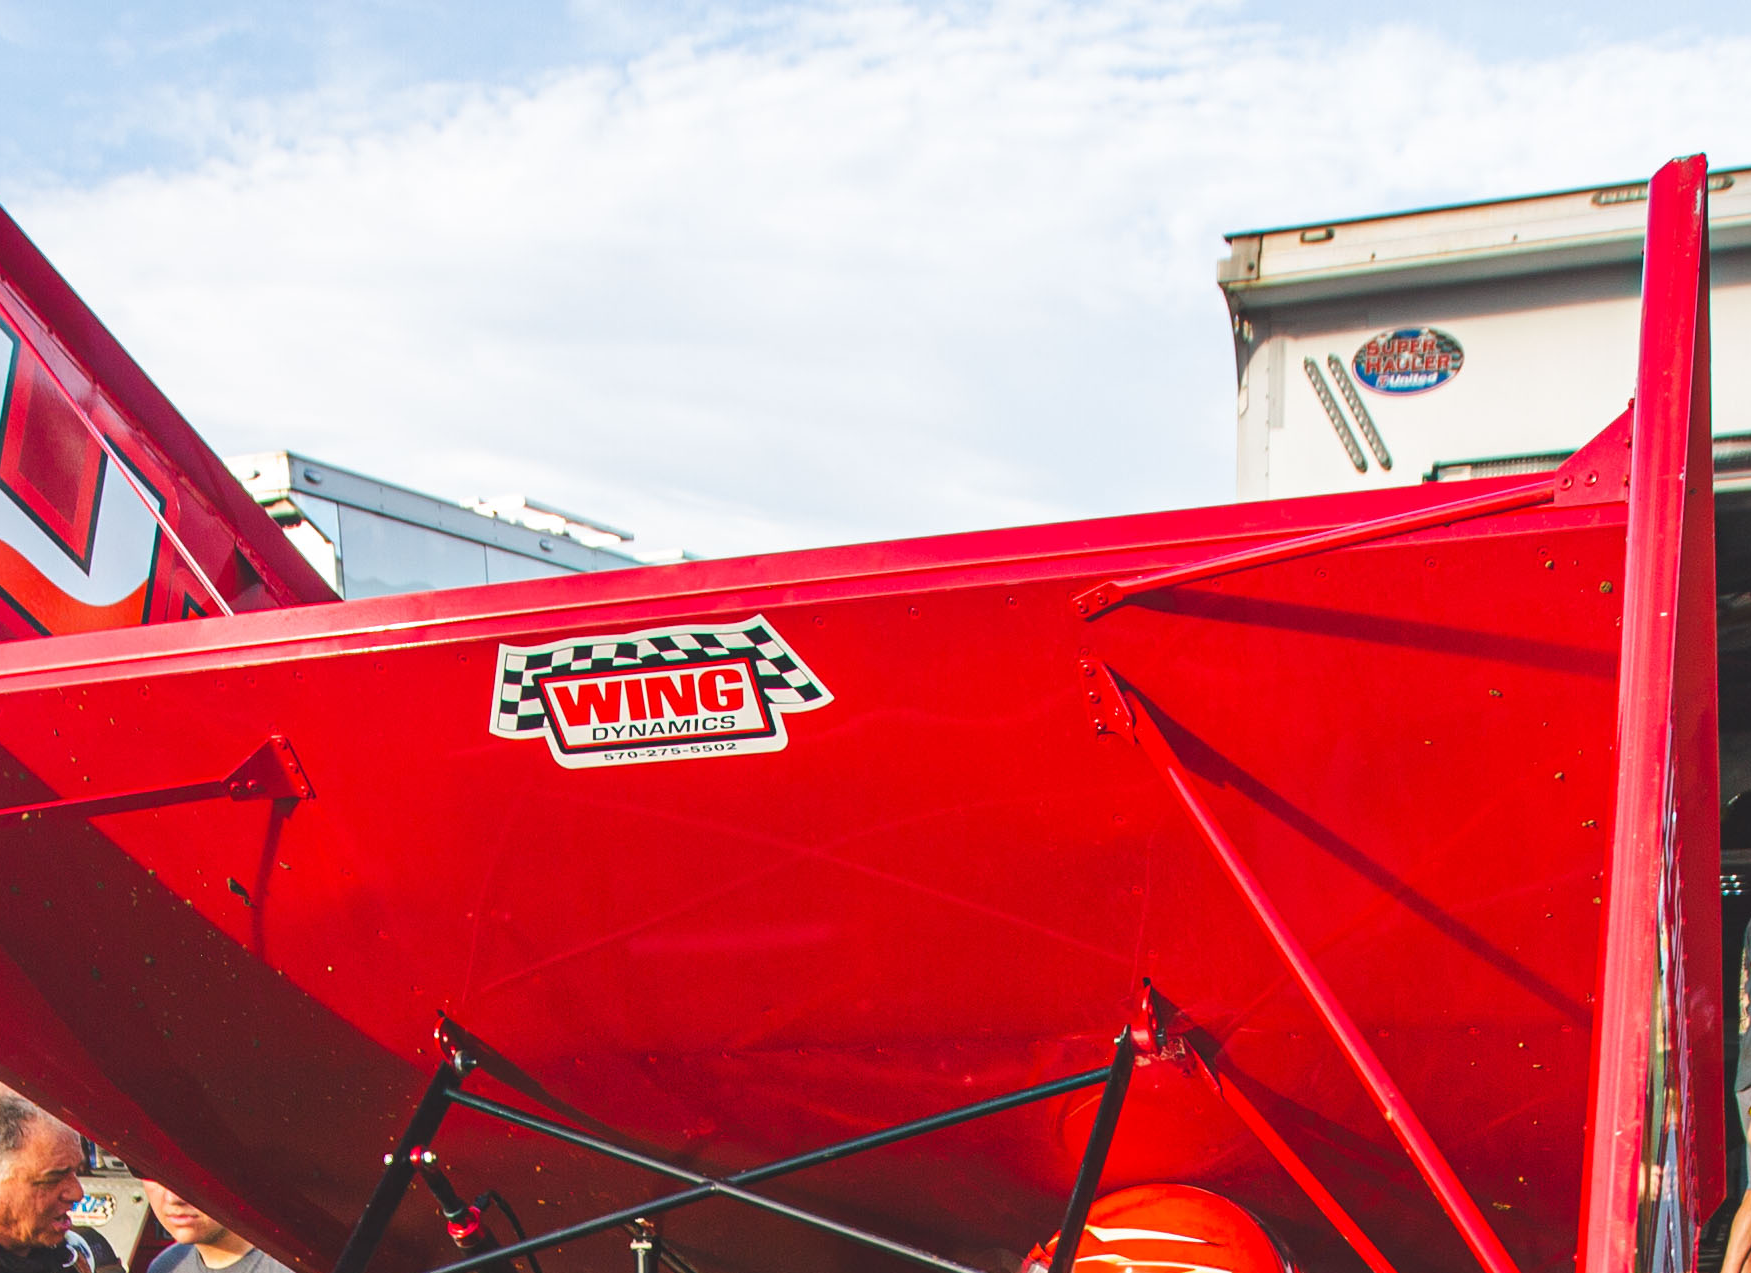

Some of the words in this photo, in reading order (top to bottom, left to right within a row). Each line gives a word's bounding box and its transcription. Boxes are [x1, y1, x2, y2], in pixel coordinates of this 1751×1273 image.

[1365, 337, 1436, 357] SUPER
[1365, 352, 1451, 374] HAULER
[552, 668, 744, 727] WING
[592, 715, 736, 741] DYNAMICS
[604, 742, 738, 761] 570-275-5502
